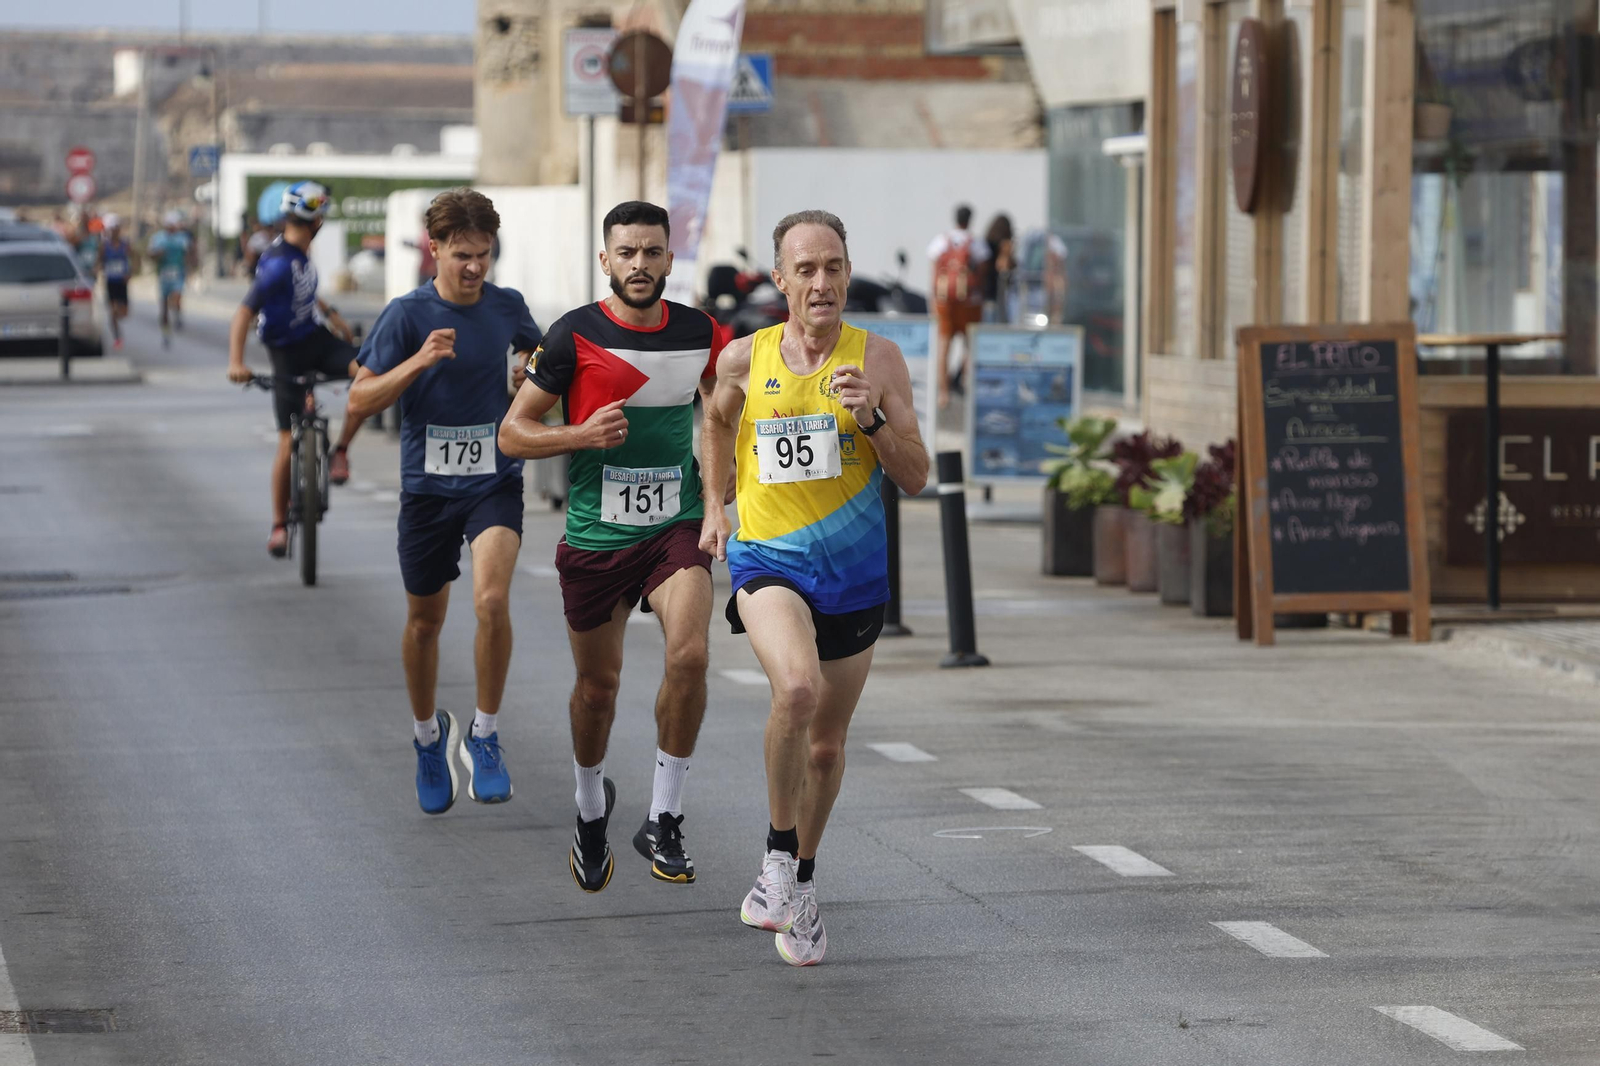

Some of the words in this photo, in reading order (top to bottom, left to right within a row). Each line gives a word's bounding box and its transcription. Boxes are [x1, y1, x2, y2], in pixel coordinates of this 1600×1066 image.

[1276, 343, 1307, 369] EL
[1310, 341, 1380, 367] PATIO
[786, 420, 805, 435] ELA
[805, 420, 828, 431] TARIFA
[439, 440, 482, 465] 179
[776, 435, 814, 469] 95
[1348, 448, 1372, 470] de
[638, 472, 653, 484] ELA
[655, 471, 675, 481] TARIFA
[619, 483, 664, 514] 151
